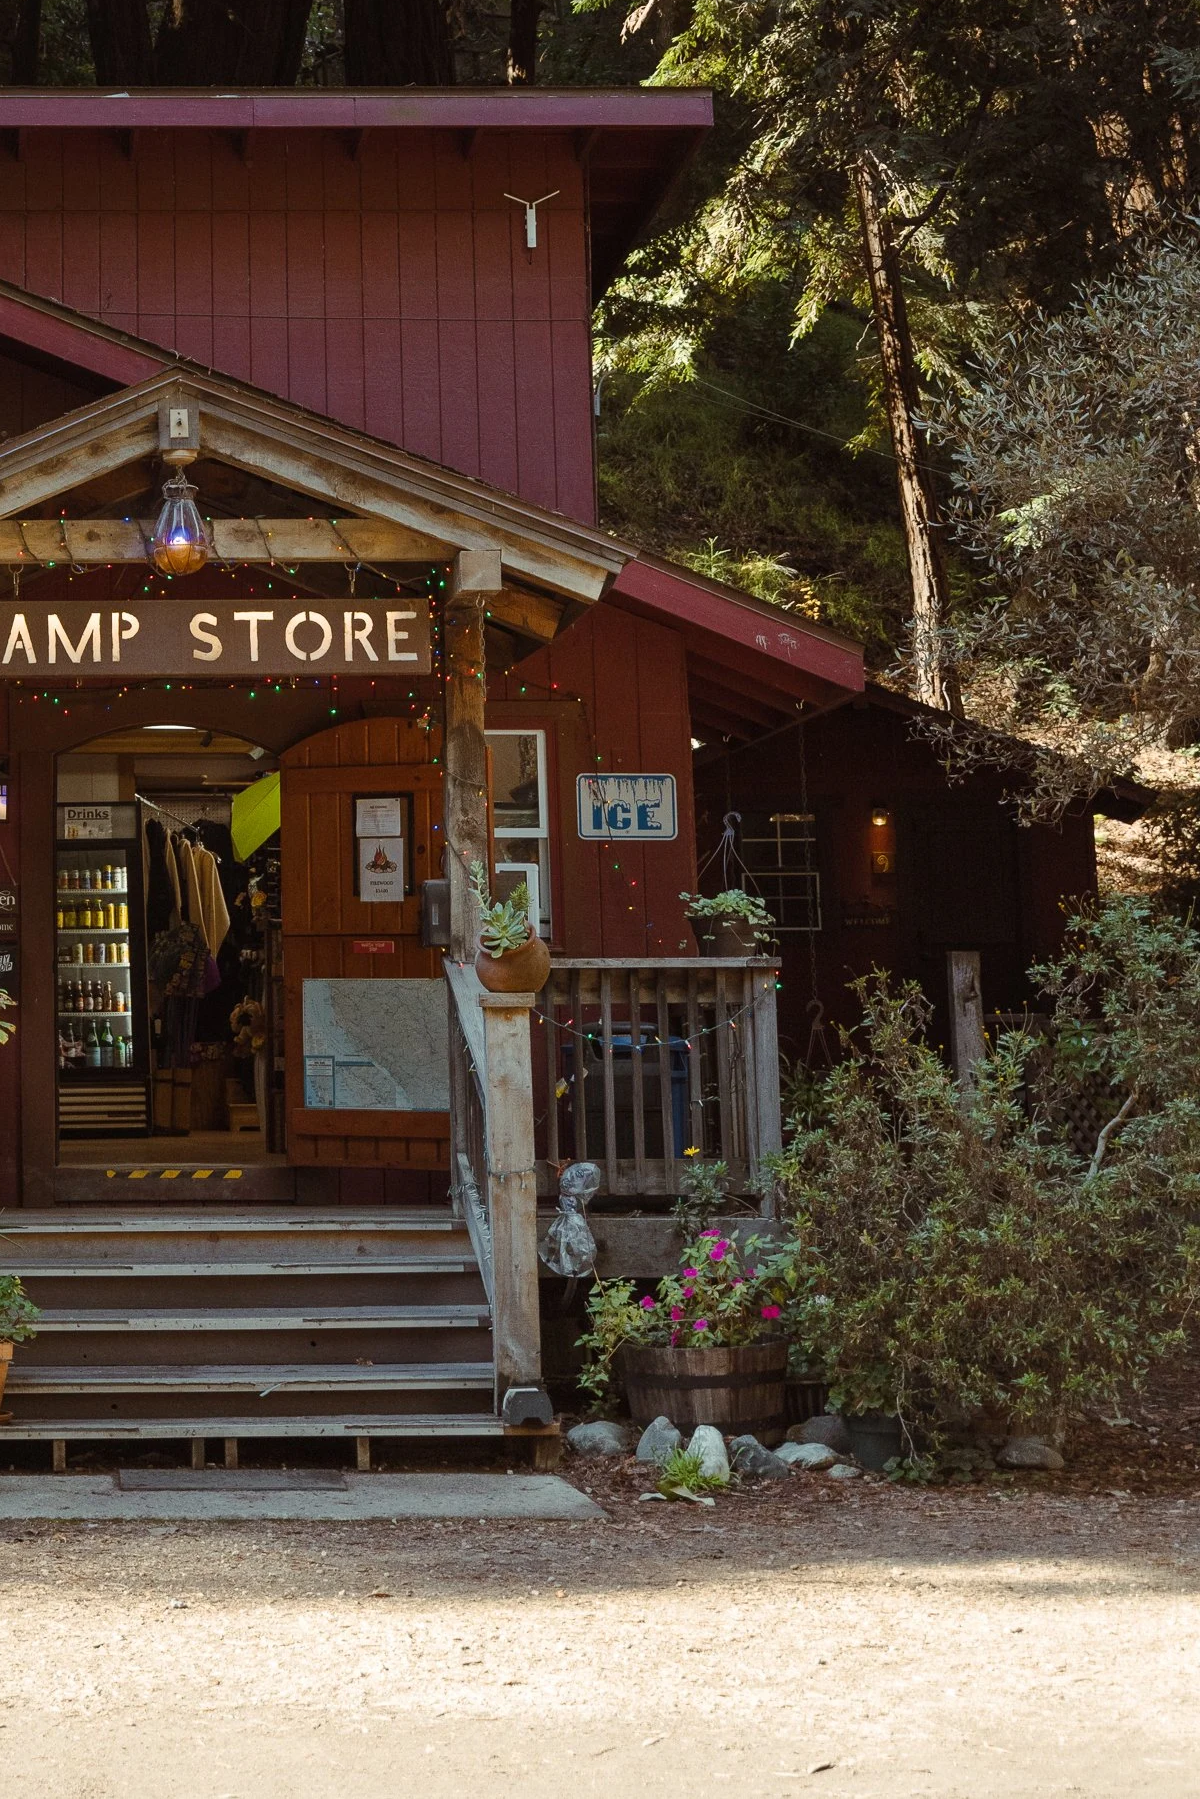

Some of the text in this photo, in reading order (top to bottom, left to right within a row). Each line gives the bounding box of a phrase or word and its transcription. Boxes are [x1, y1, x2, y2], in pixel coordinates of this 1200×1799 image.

[189, 611, 419, 662] STORE
[67, 808, 110, 819] Drinks
[592, 799, 662, 831] ICE
